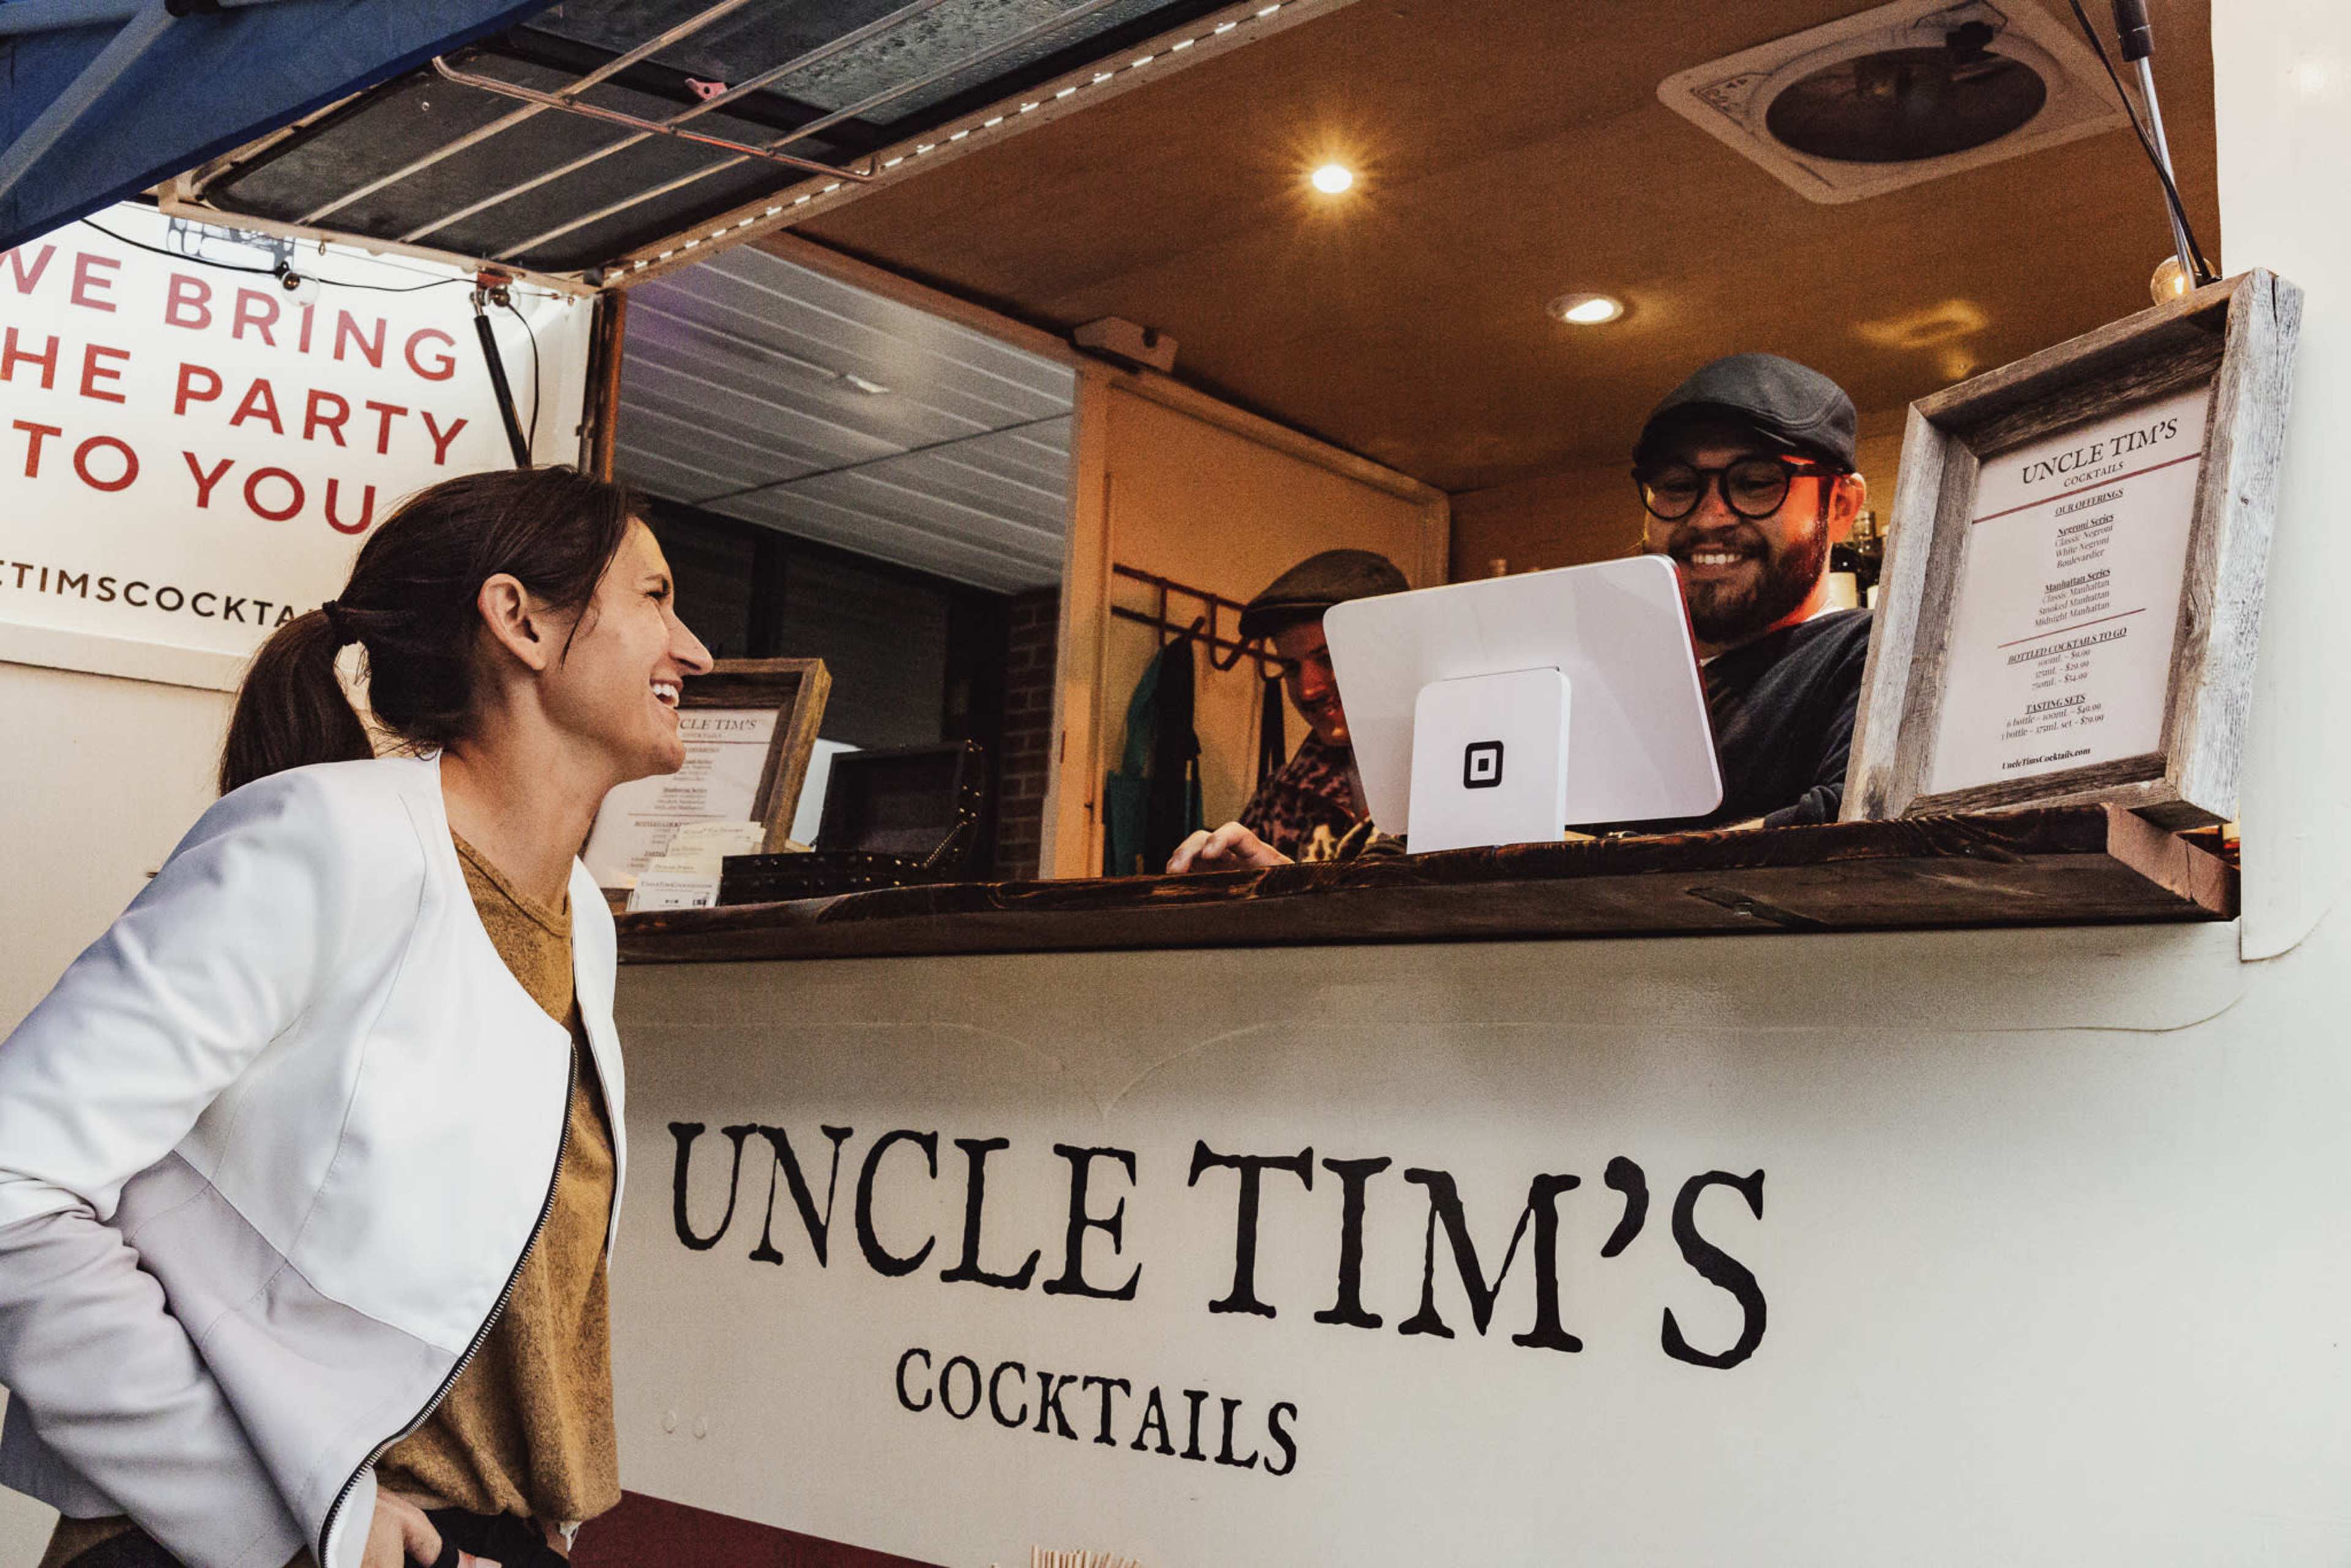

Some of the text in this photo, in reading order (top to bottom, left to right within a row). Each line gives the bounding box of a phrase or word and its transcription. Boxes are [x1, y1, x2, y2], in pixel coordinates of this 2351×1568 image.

[164, 273, 457, 381] BRING
[173, 362, 468, 467] PARTY
[12, 419, 376, 535] TO YOU
[2023, 418, 2178, 484] UNCLE TIM'S
[2063, 461, 2124, 487] COCKTAILS
[2055, 488, 2124, 517] OUR OFFERINGS
[2090, 514, 2114, 527] Series
[0, 560, 313, 627] TIMSCOCKTA
[2044, 568, 2111, 595] Manhattan Series
[2008, 627, 2128, 665] BOTTLED COCKTAILS TO GO
[680, 718, 710, 730] CLE
[2026, 694, 2087, 715] TASTING SETS
[668, 1120, 1768, 1370] UNCLE TIM'S
[895, 1347, 1299, 1477] COCKTAILS
